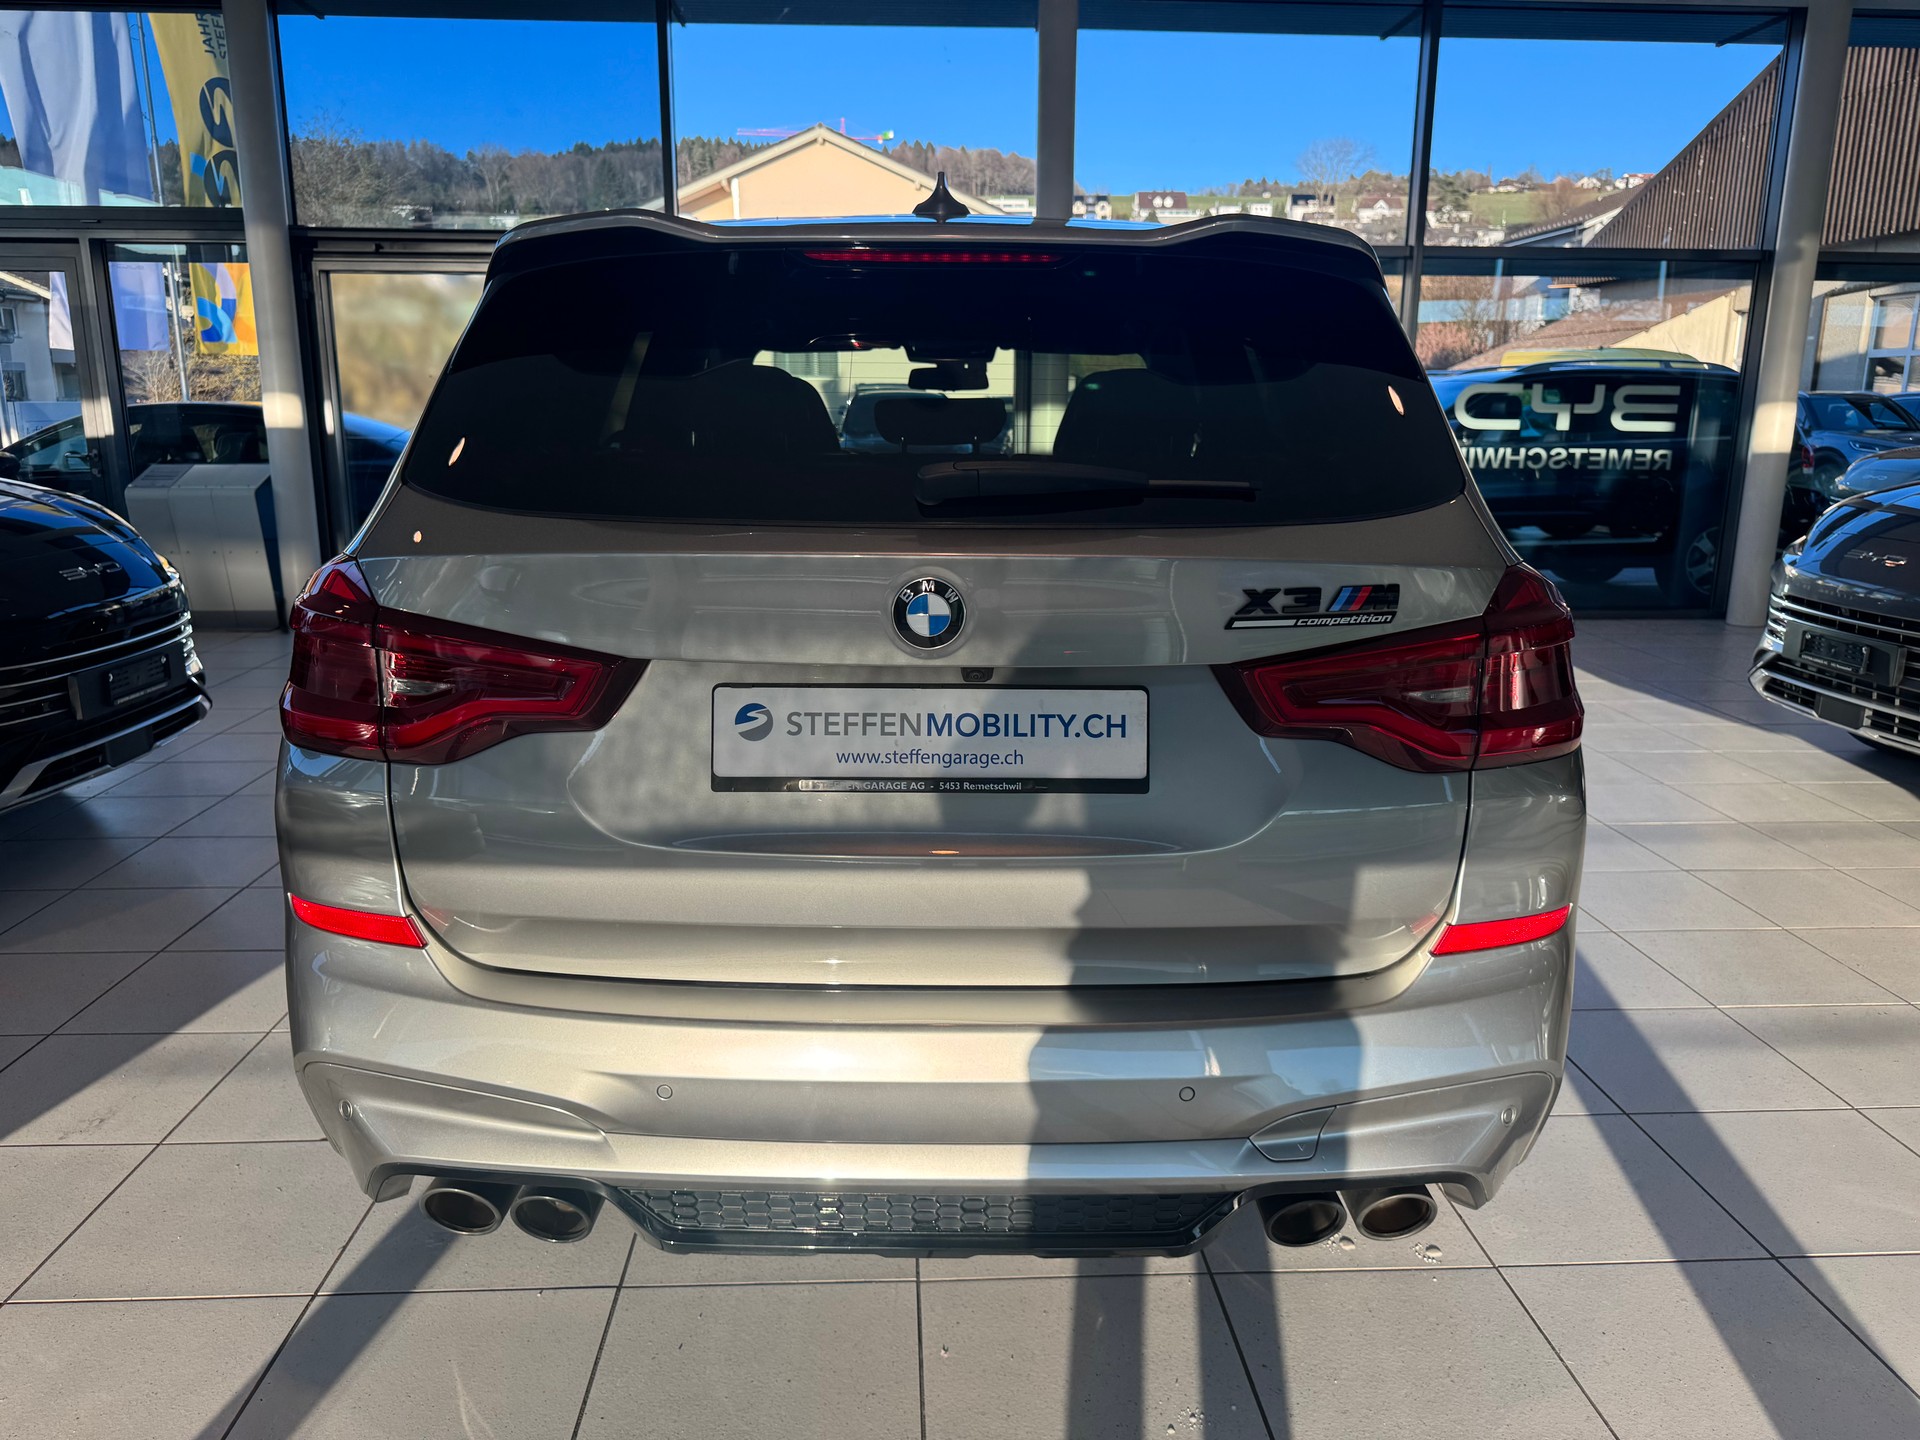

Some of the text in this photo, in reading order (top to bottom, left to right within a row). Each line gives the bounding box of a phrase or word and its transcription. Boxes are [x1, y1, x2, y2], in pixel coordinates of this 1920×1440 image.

[900, 580, 959, 603] BMW
[1235, 587, 1322, 615] X3
[1297, 614, 1392, 626] competition
[786, 711, 1127, 739] STEFFENMOBILITY.CH
[836, 748, 1024, 768] www.steffengarage.ch
[863, 781, 907, 791] GARAGE
[909, 781, 925, 791] AG
[939, 781, 960, 791] 5453
[963, 781, 1022, 791] Remetschwil
